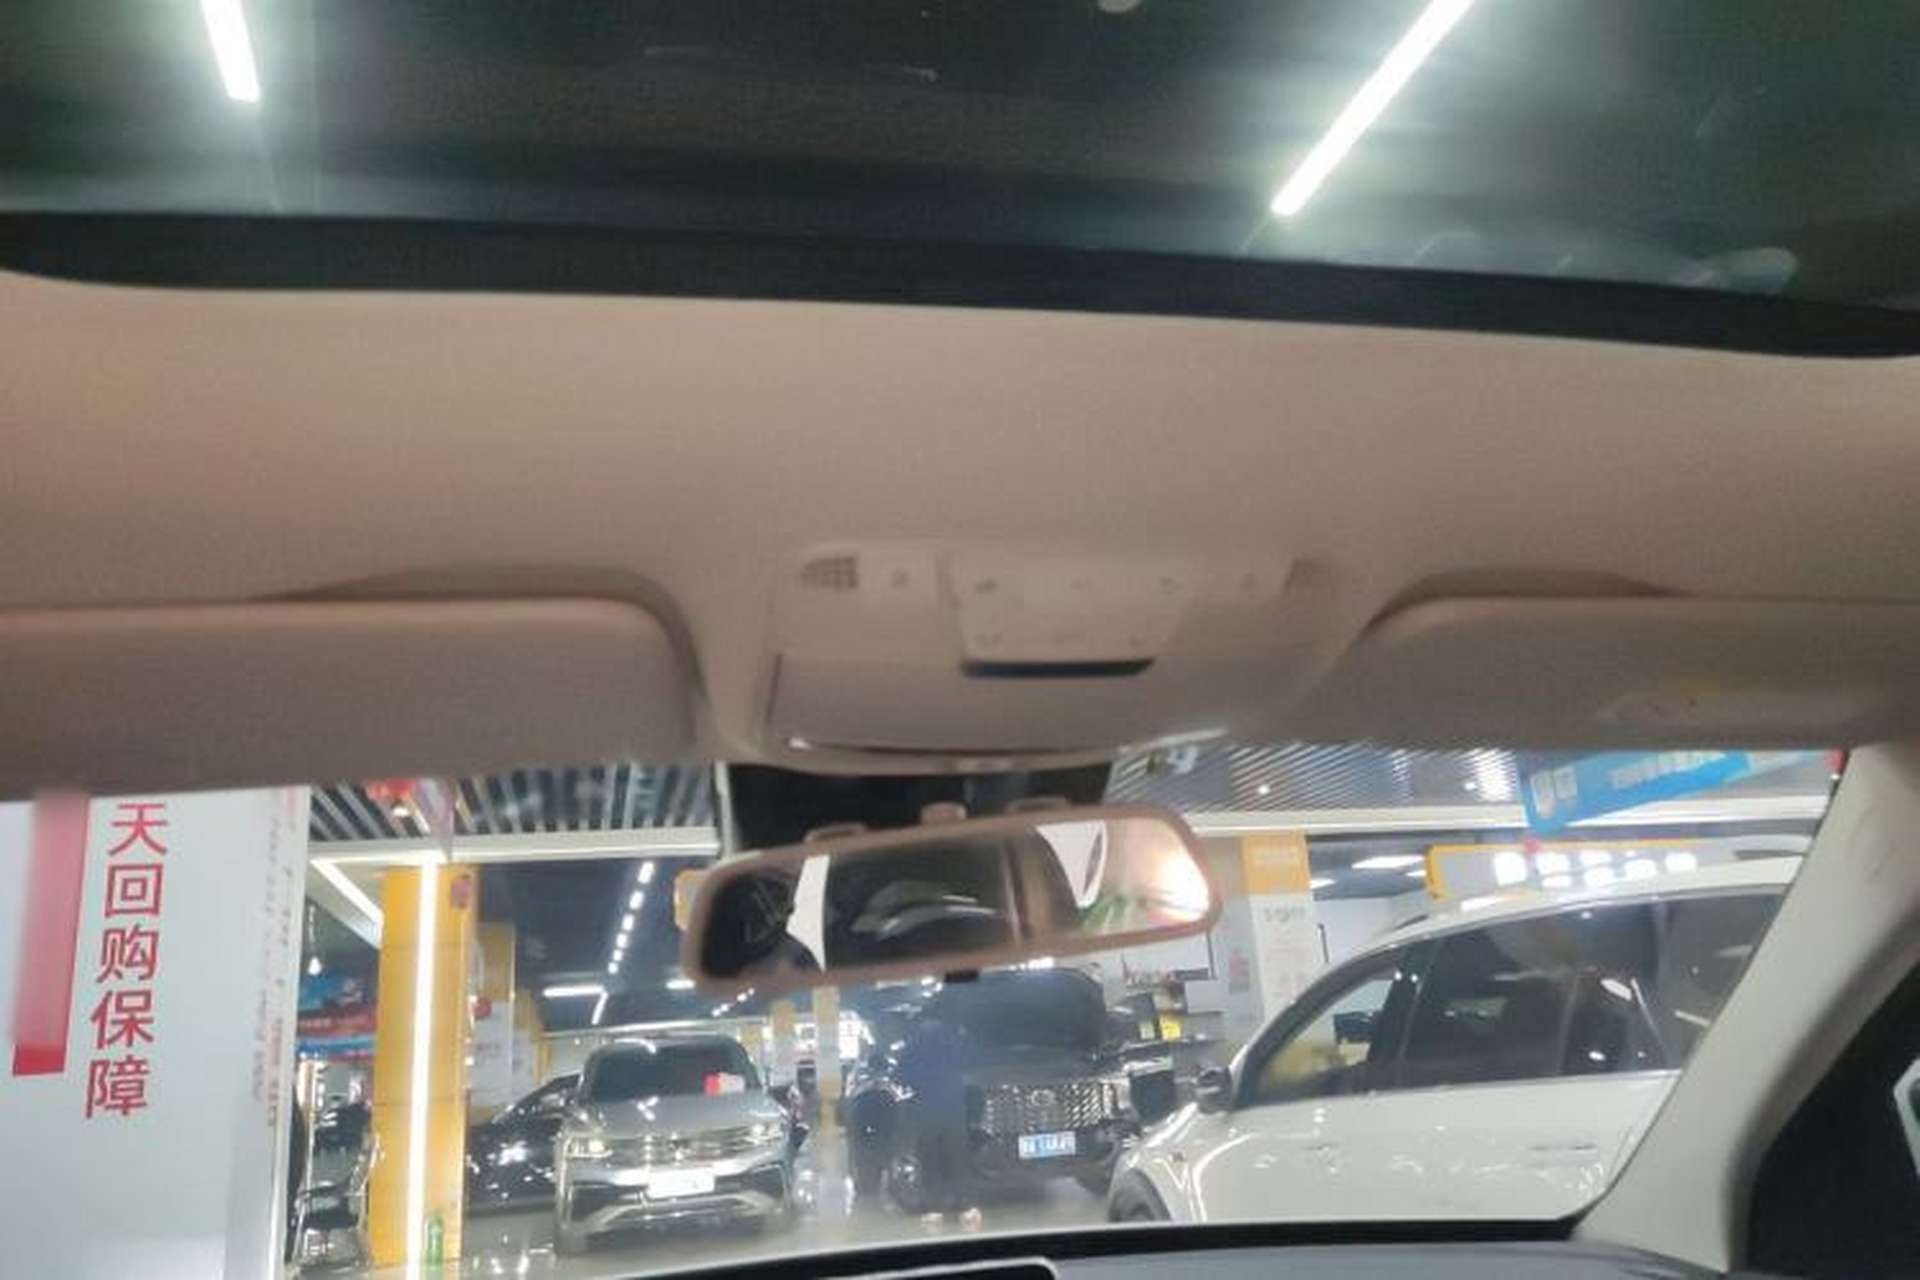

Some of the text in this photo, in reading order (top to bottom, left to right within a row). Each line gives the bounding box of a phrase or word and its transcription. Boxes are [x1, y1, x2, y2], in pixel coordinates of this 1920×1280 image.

[85, 803, 168, 1119] 天回购保障
